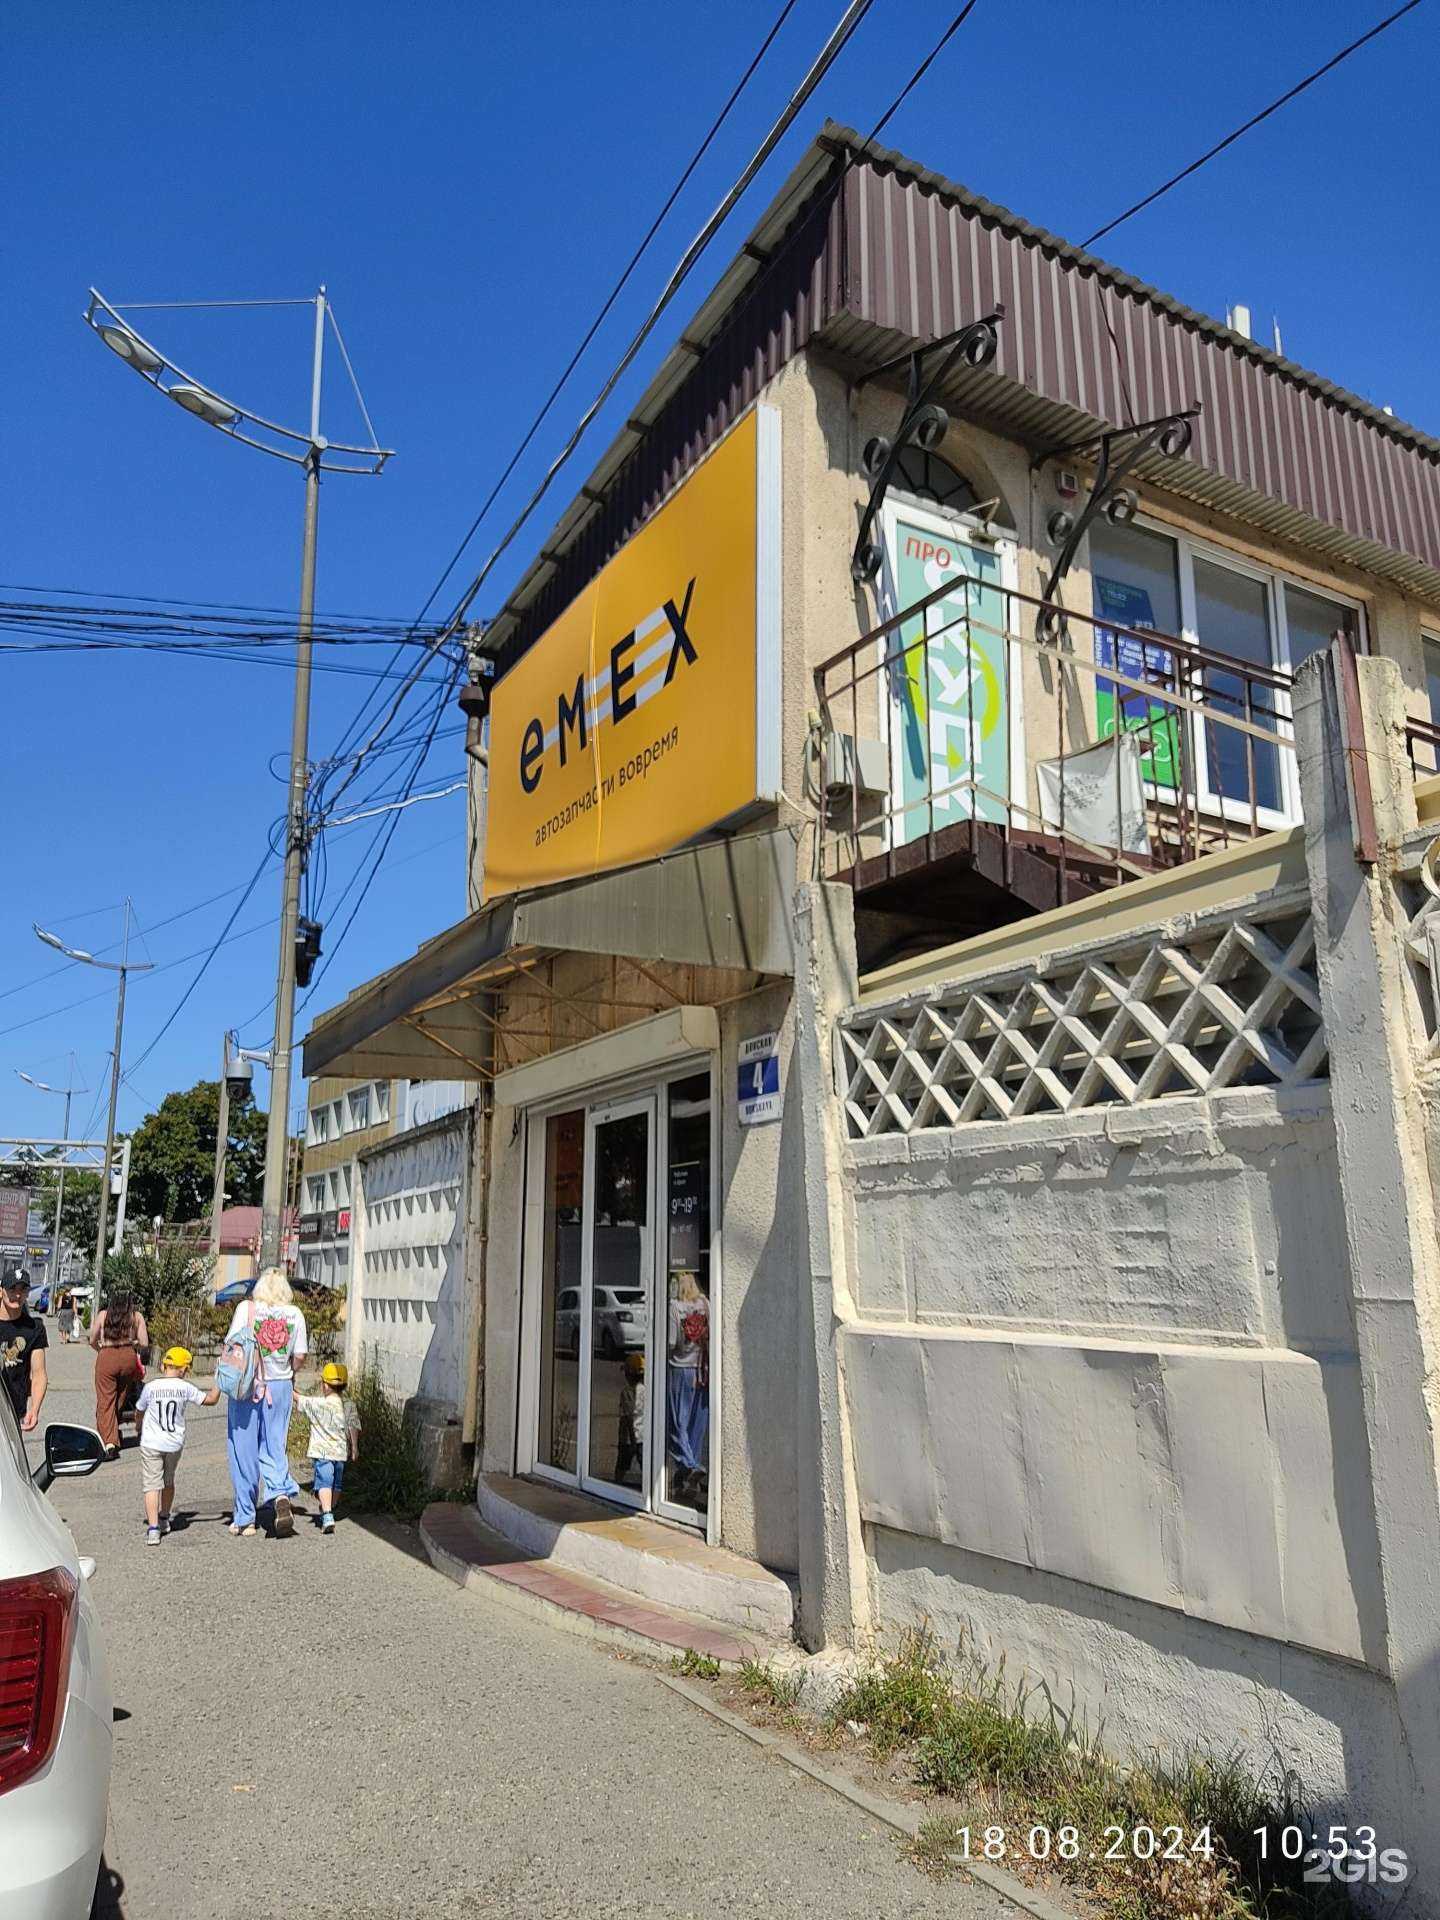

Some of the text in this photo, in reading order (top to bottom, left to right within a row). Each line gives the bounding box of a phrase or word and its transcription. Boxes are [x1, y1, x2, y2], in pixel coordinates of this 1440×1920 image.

[904, 536, 951, 569] ПРО
[535, 726, 679, 848] автозапчасти вовремя
[752, 1061, 764, 1095] 4
[155, 1400, 177, 1433] 10
